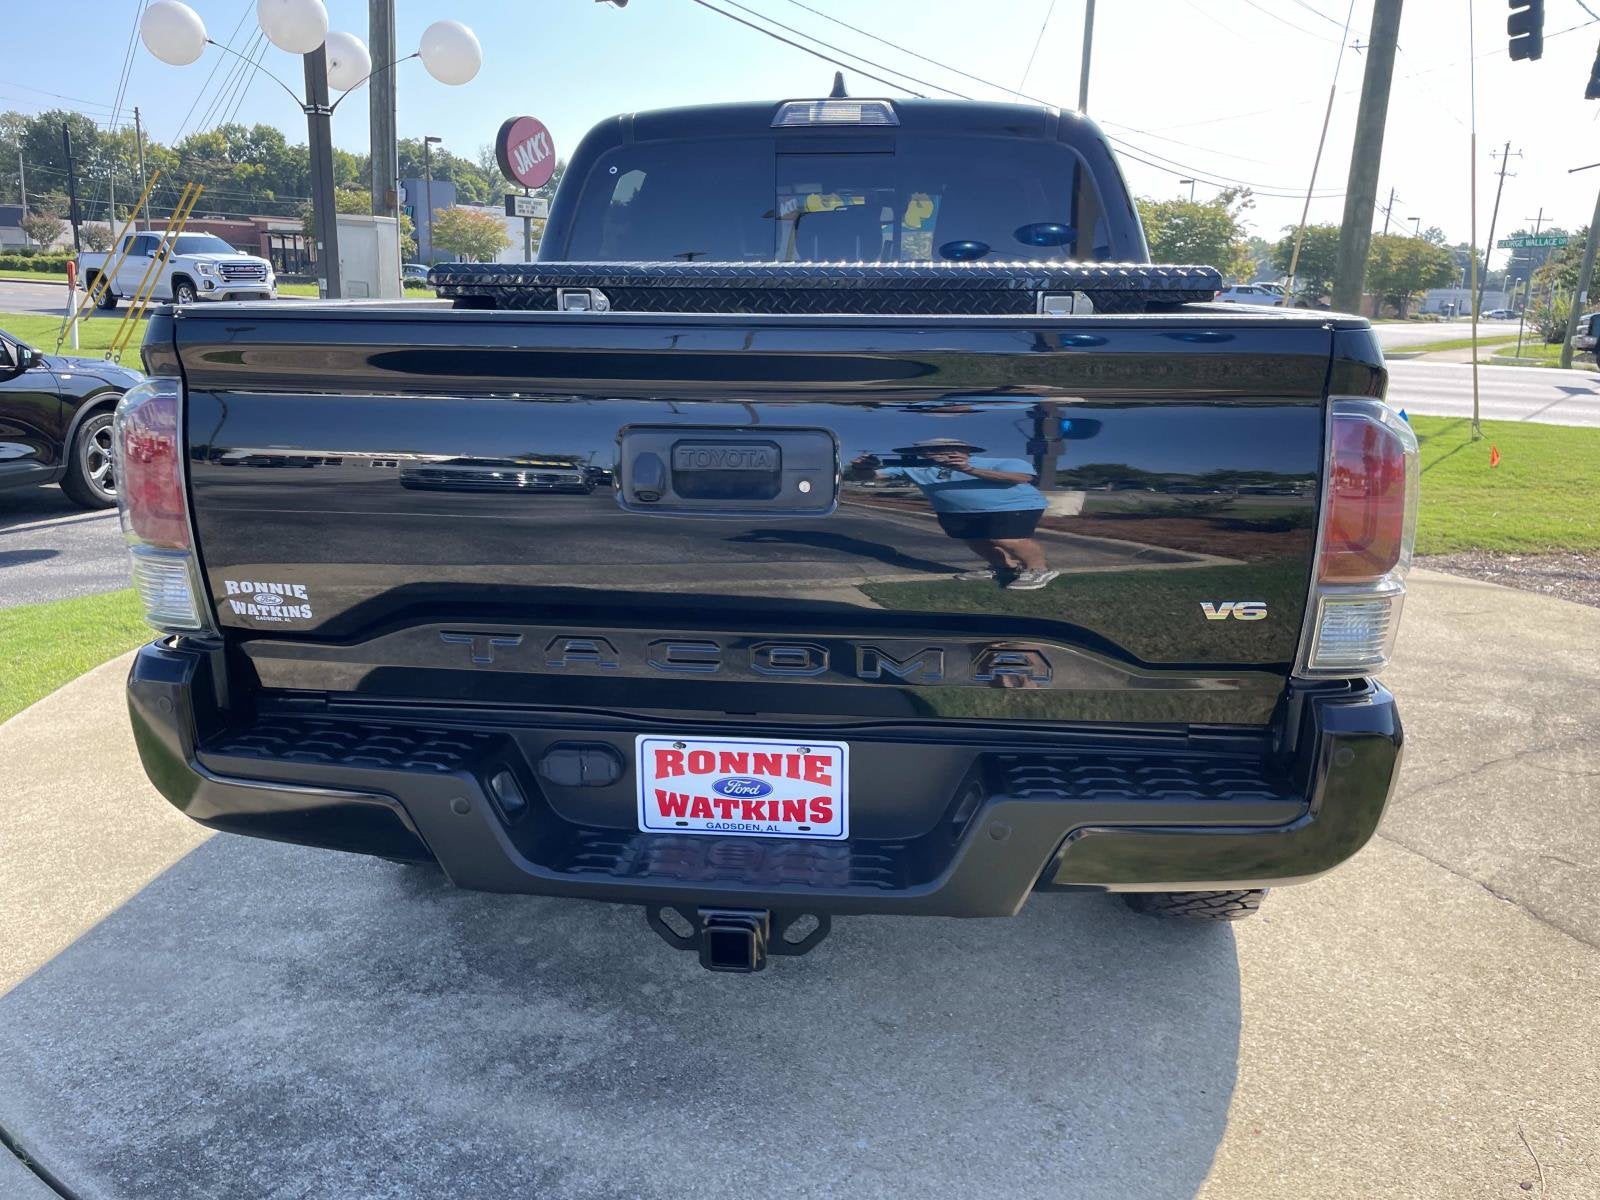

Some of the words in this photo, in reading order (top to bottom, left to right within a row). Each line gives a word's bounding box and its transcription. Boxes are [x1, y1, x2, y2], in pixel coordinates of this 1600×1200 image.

[1499, 239, 1523, 248] GEORGE
[1525, 238, 1558, 247] WALLACE
[680, 449, 772, 469] TOYOTA
[225, 580, 308, 600] RONNIE
[229, 600, 312, 619] WATKINS
[1200, 602, 1267, 620] V6
[440, 630, 1053, 682] TACOMA
[655, 750, 832, 787] RONNIE
[723, 780, 760, 796] Ford
[655, 789, 833, 823] WATKINS
[706, 822, 763, 832] GADSDEN,
[766, 824, 781, 832] AL
